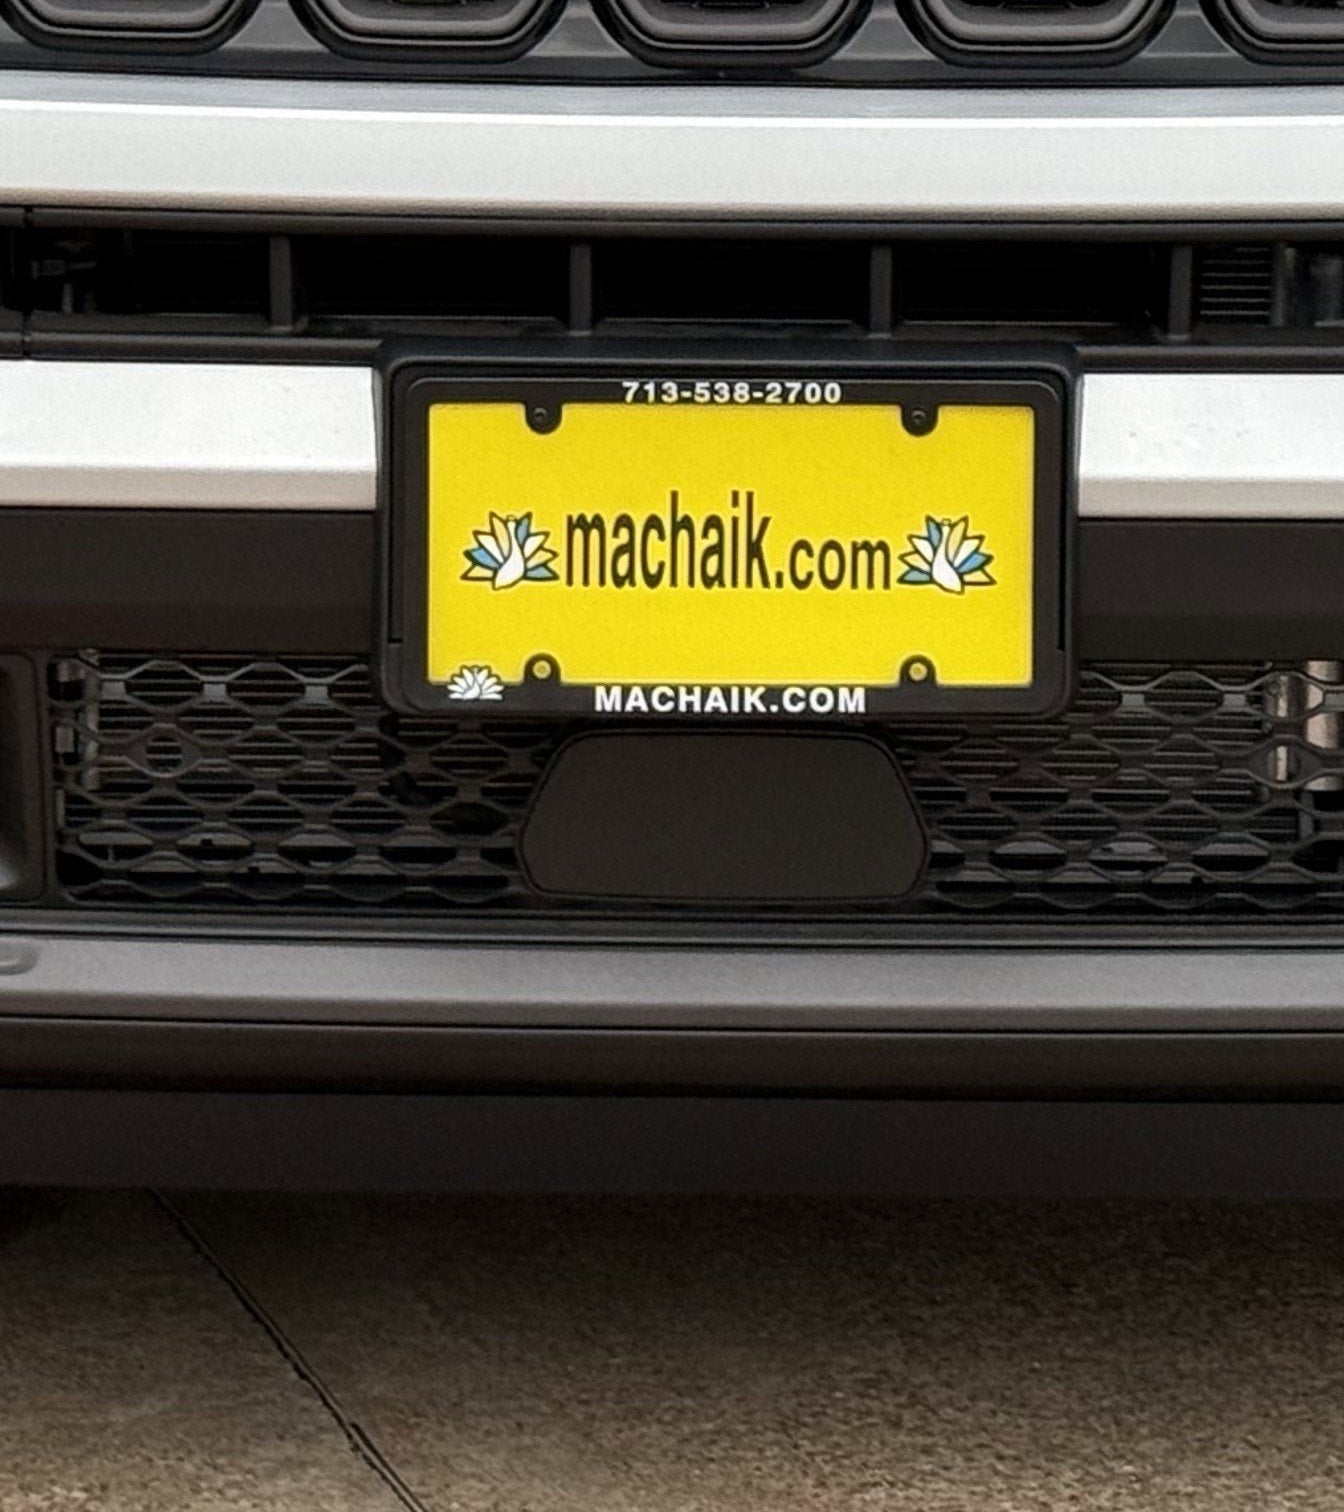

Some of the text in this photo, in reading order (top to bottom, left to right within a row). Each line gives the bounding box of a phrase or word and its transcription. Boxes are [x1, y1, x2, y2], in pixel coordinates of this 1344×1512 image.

[621, 381, 843, 404] 713-538-2700
[564, 490, 892, 591] machaik.com
[594, 685, 867, 714] MACHAIK.COM
